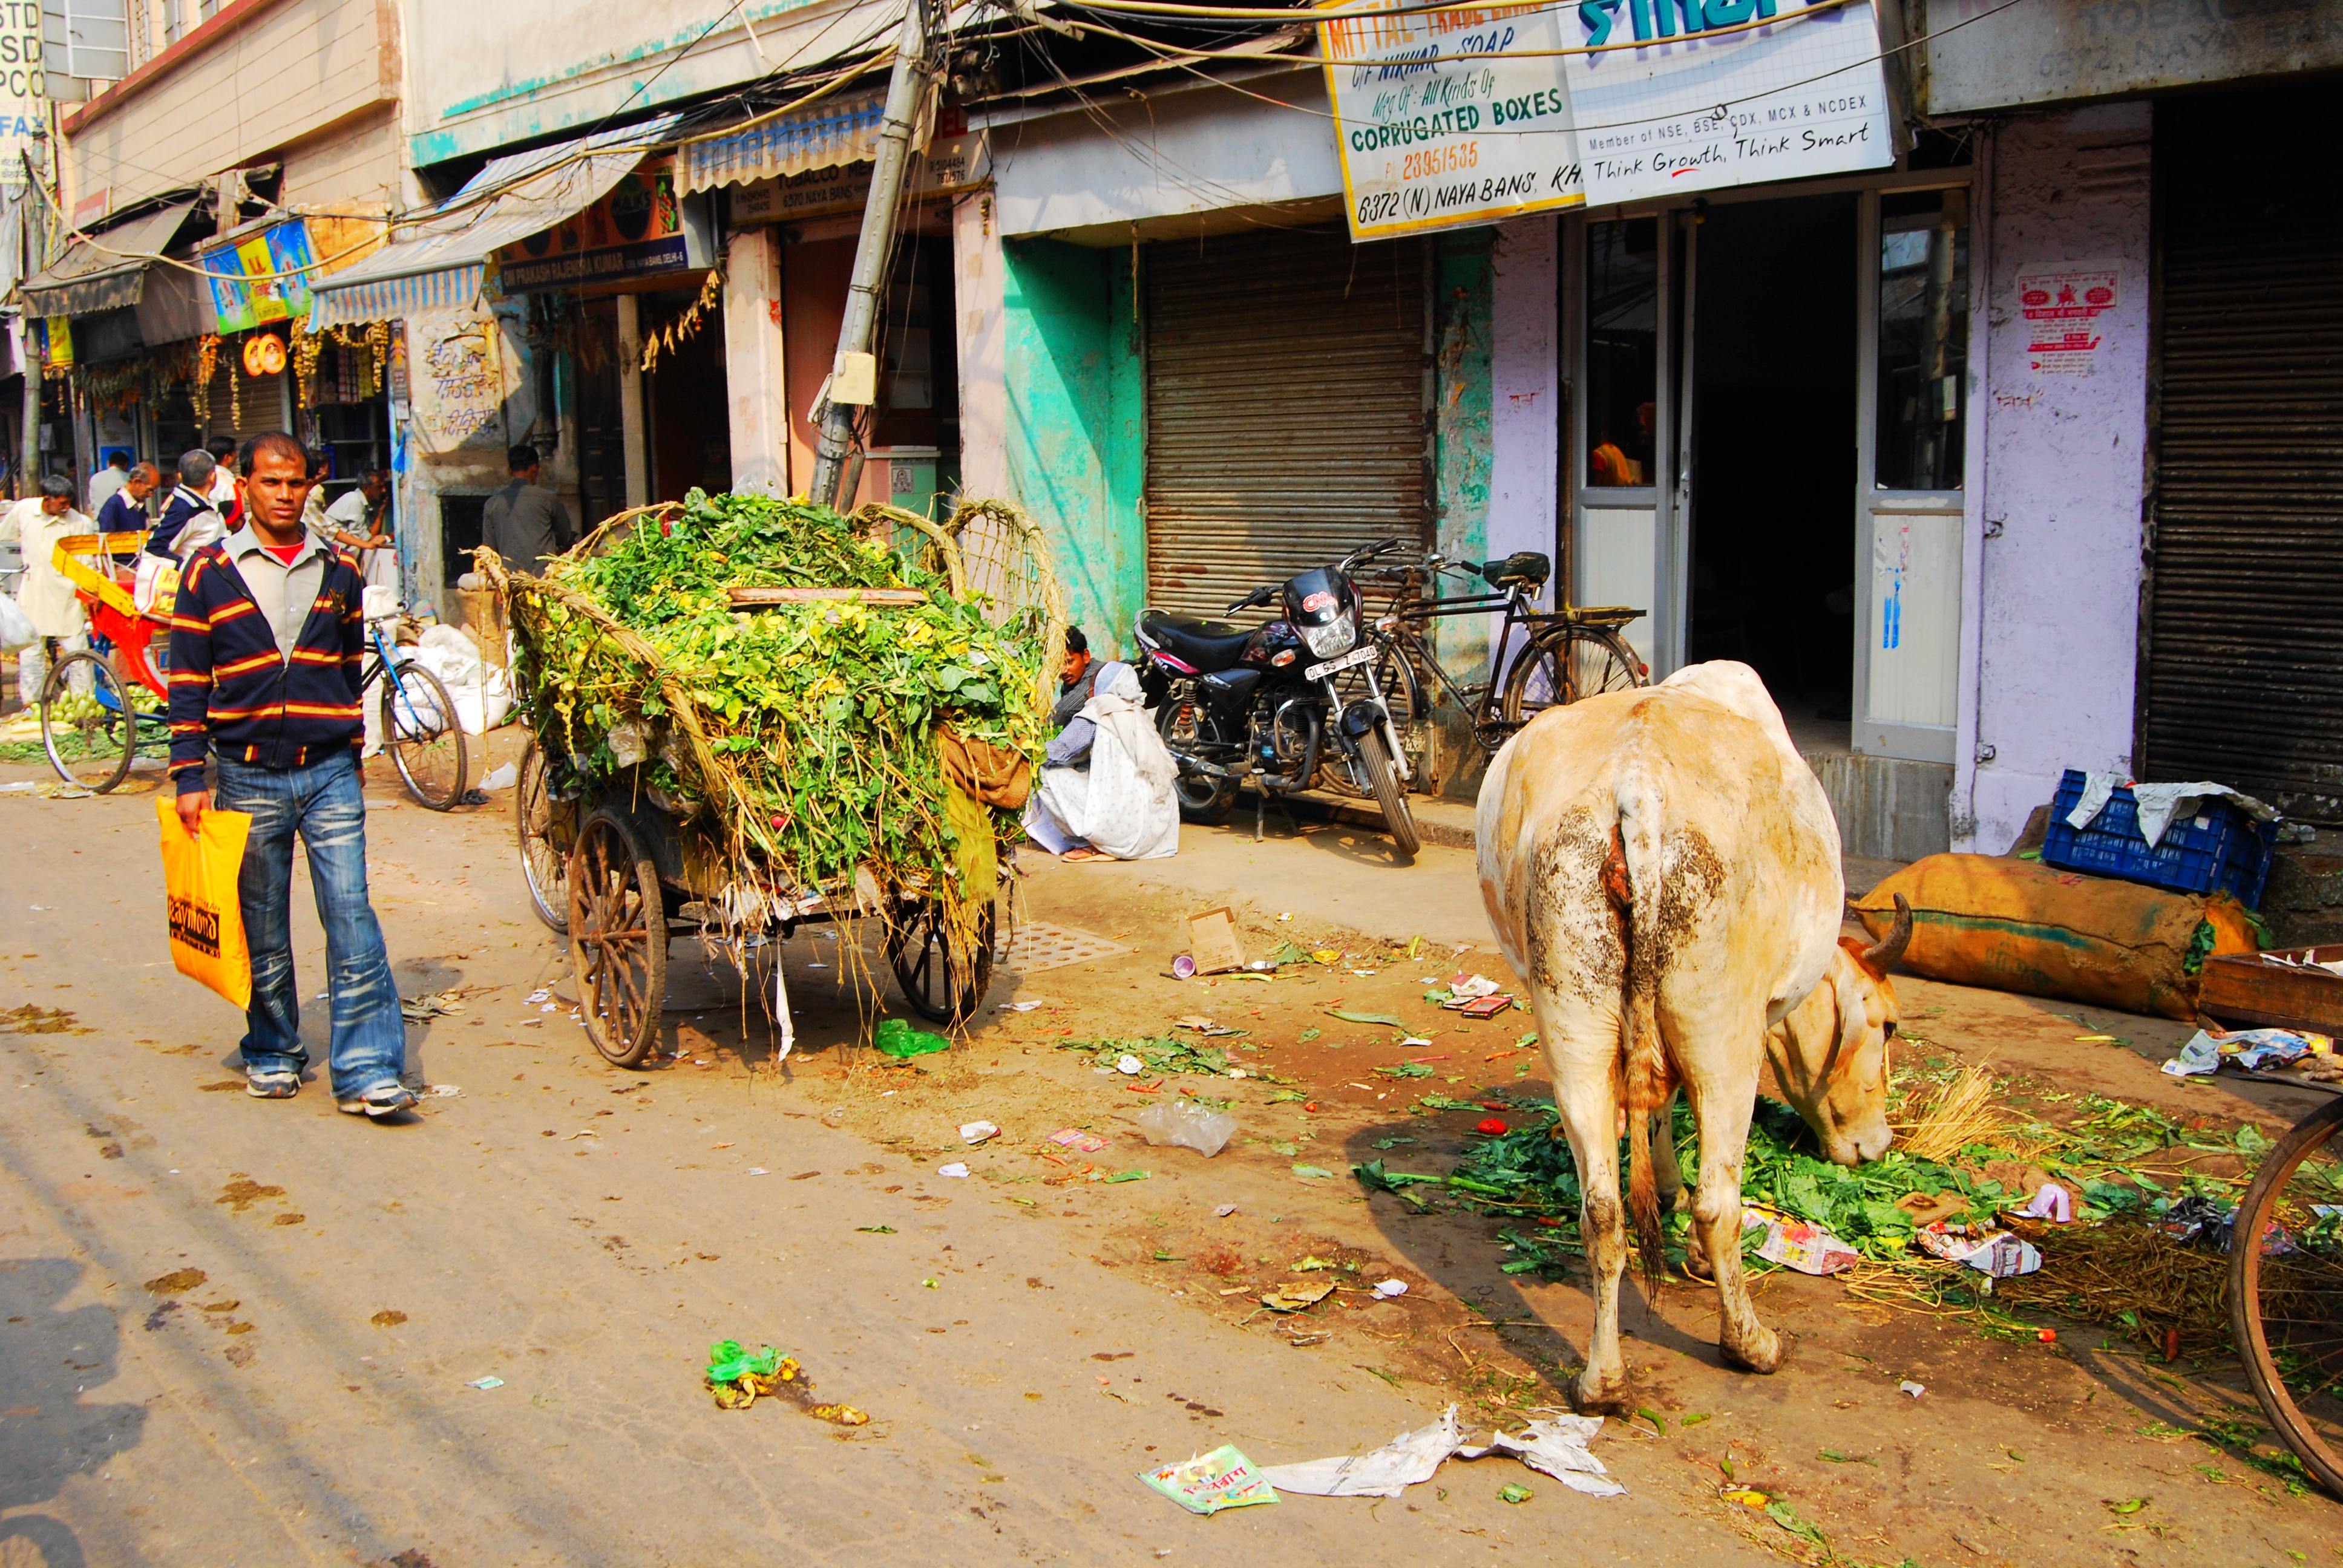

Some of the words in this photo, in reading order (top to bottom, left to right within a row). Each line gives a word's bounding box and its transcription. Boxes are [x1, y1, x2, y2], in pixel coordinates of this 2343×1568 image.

[0, 2, 38, 28] TD
[1328, 2, 1415, 59] MITTAL
[1378, 44, 1439, 82] NIKHAR
[1457, 27, 1515, 62] SOAP
[1441, 72, 1477, 108] Kinds
[1481, 68, 1495, 99] Of
[1351, 105, 1480, 152] CORRUGATED
[1492, 87, 1562, 125] BOXES
[1590, 133, 1635, 151] Member
[1640, 129, 1654, 143] of
[1659, 123, 1688, 140] NSE,
[1694, 117, 1723, 134] BSE,
[1768, 106, 1797, 121] MCX
[1804, 105, 1811, 117] &
[1818, 95, 1867, 114] NCDEX
[1403, 140, 1479, 181] 23951535
[1594, 158, 1643, 181] Think
[1653, 143, 1727, 172] Growth,
[1735, 135, 1791, 160] Think
[1802, 122, 1869, 151] Smart
[776, 165, 839, 190] TOBACCO
[805, 189, 827, 205] NAYA
[1435, 181, 1476, 209] NAYA
[594, 252, 625, 275] KUMAR
[1308, 666, 1321, 678] DL
[1343, 655, 1351, 665] Z
[168, 898, 217, 940] Raymond
